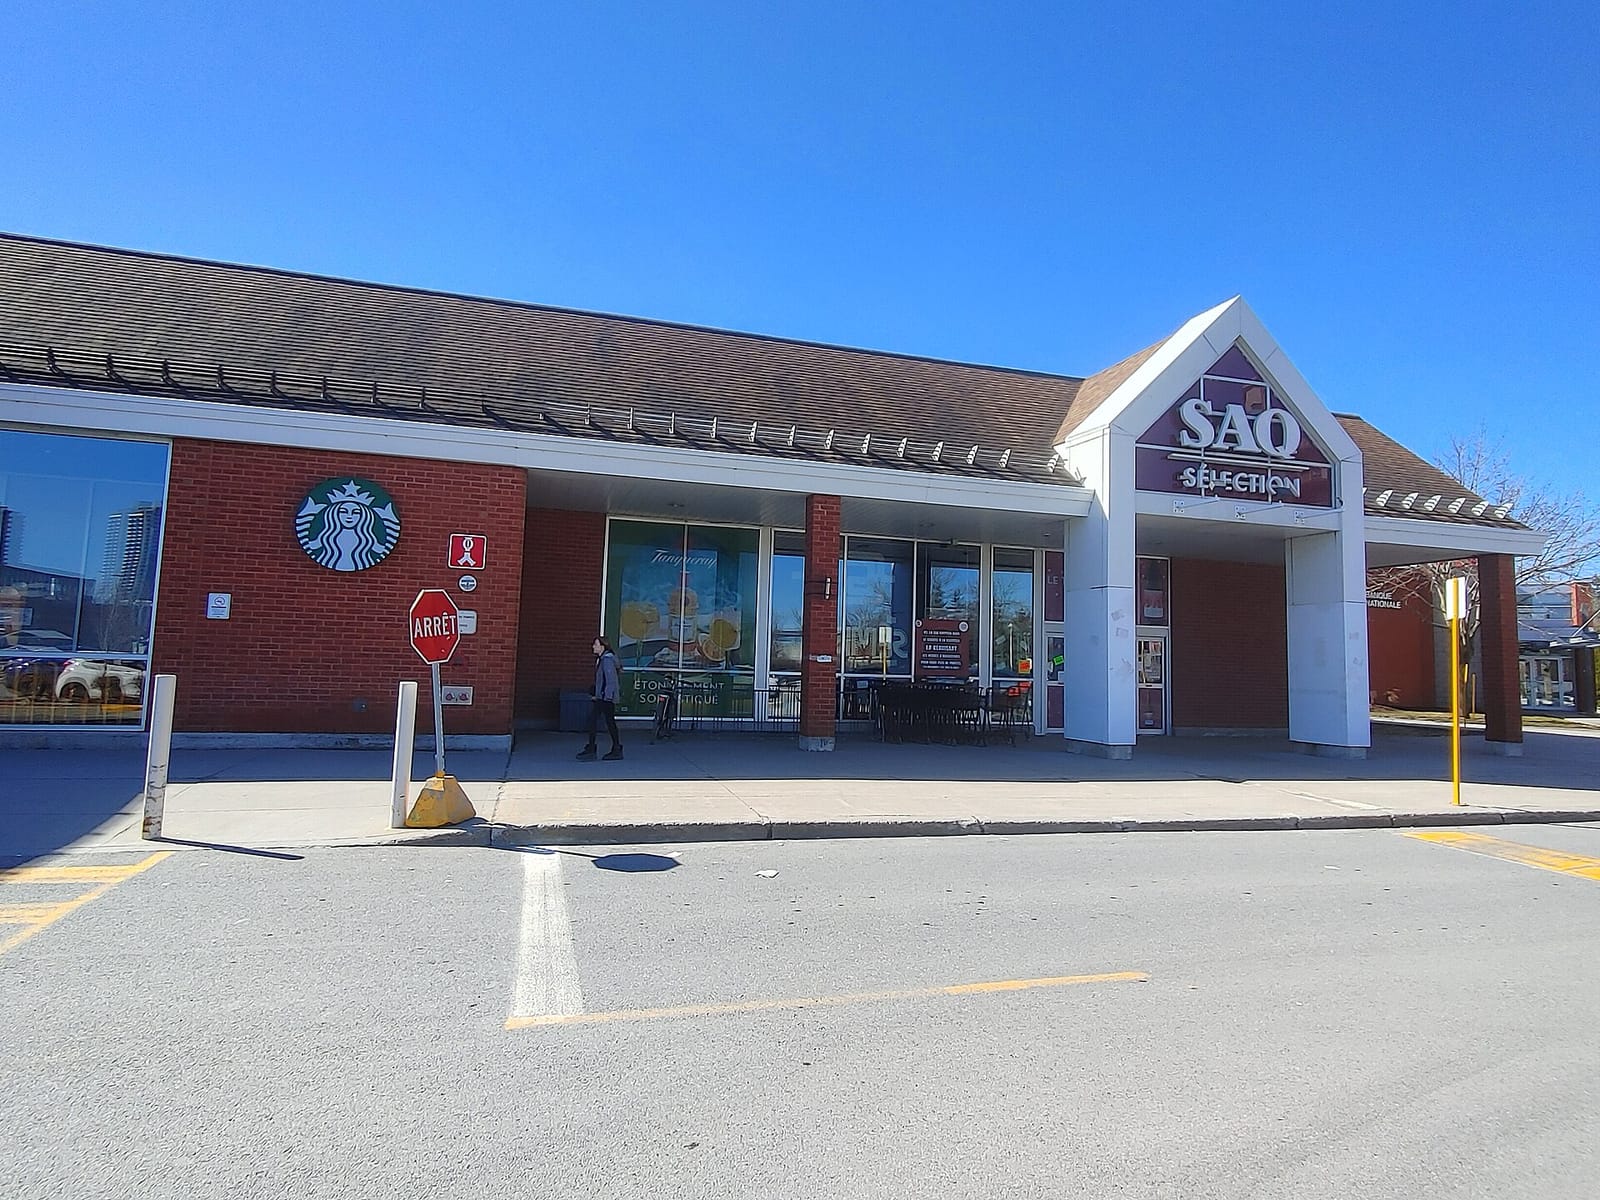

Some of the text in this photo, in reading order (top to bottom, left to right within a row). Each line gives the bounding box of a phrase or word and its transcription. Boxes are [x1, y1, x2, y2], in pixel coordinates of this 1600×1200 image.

[1179, 398, 1301, 460] SAQ
[1181, 463, 1300, 498] SÉLECTION
[651, 549, 718, 568] Tanqueray
[413, 612, 456, 639] ARRÊT
